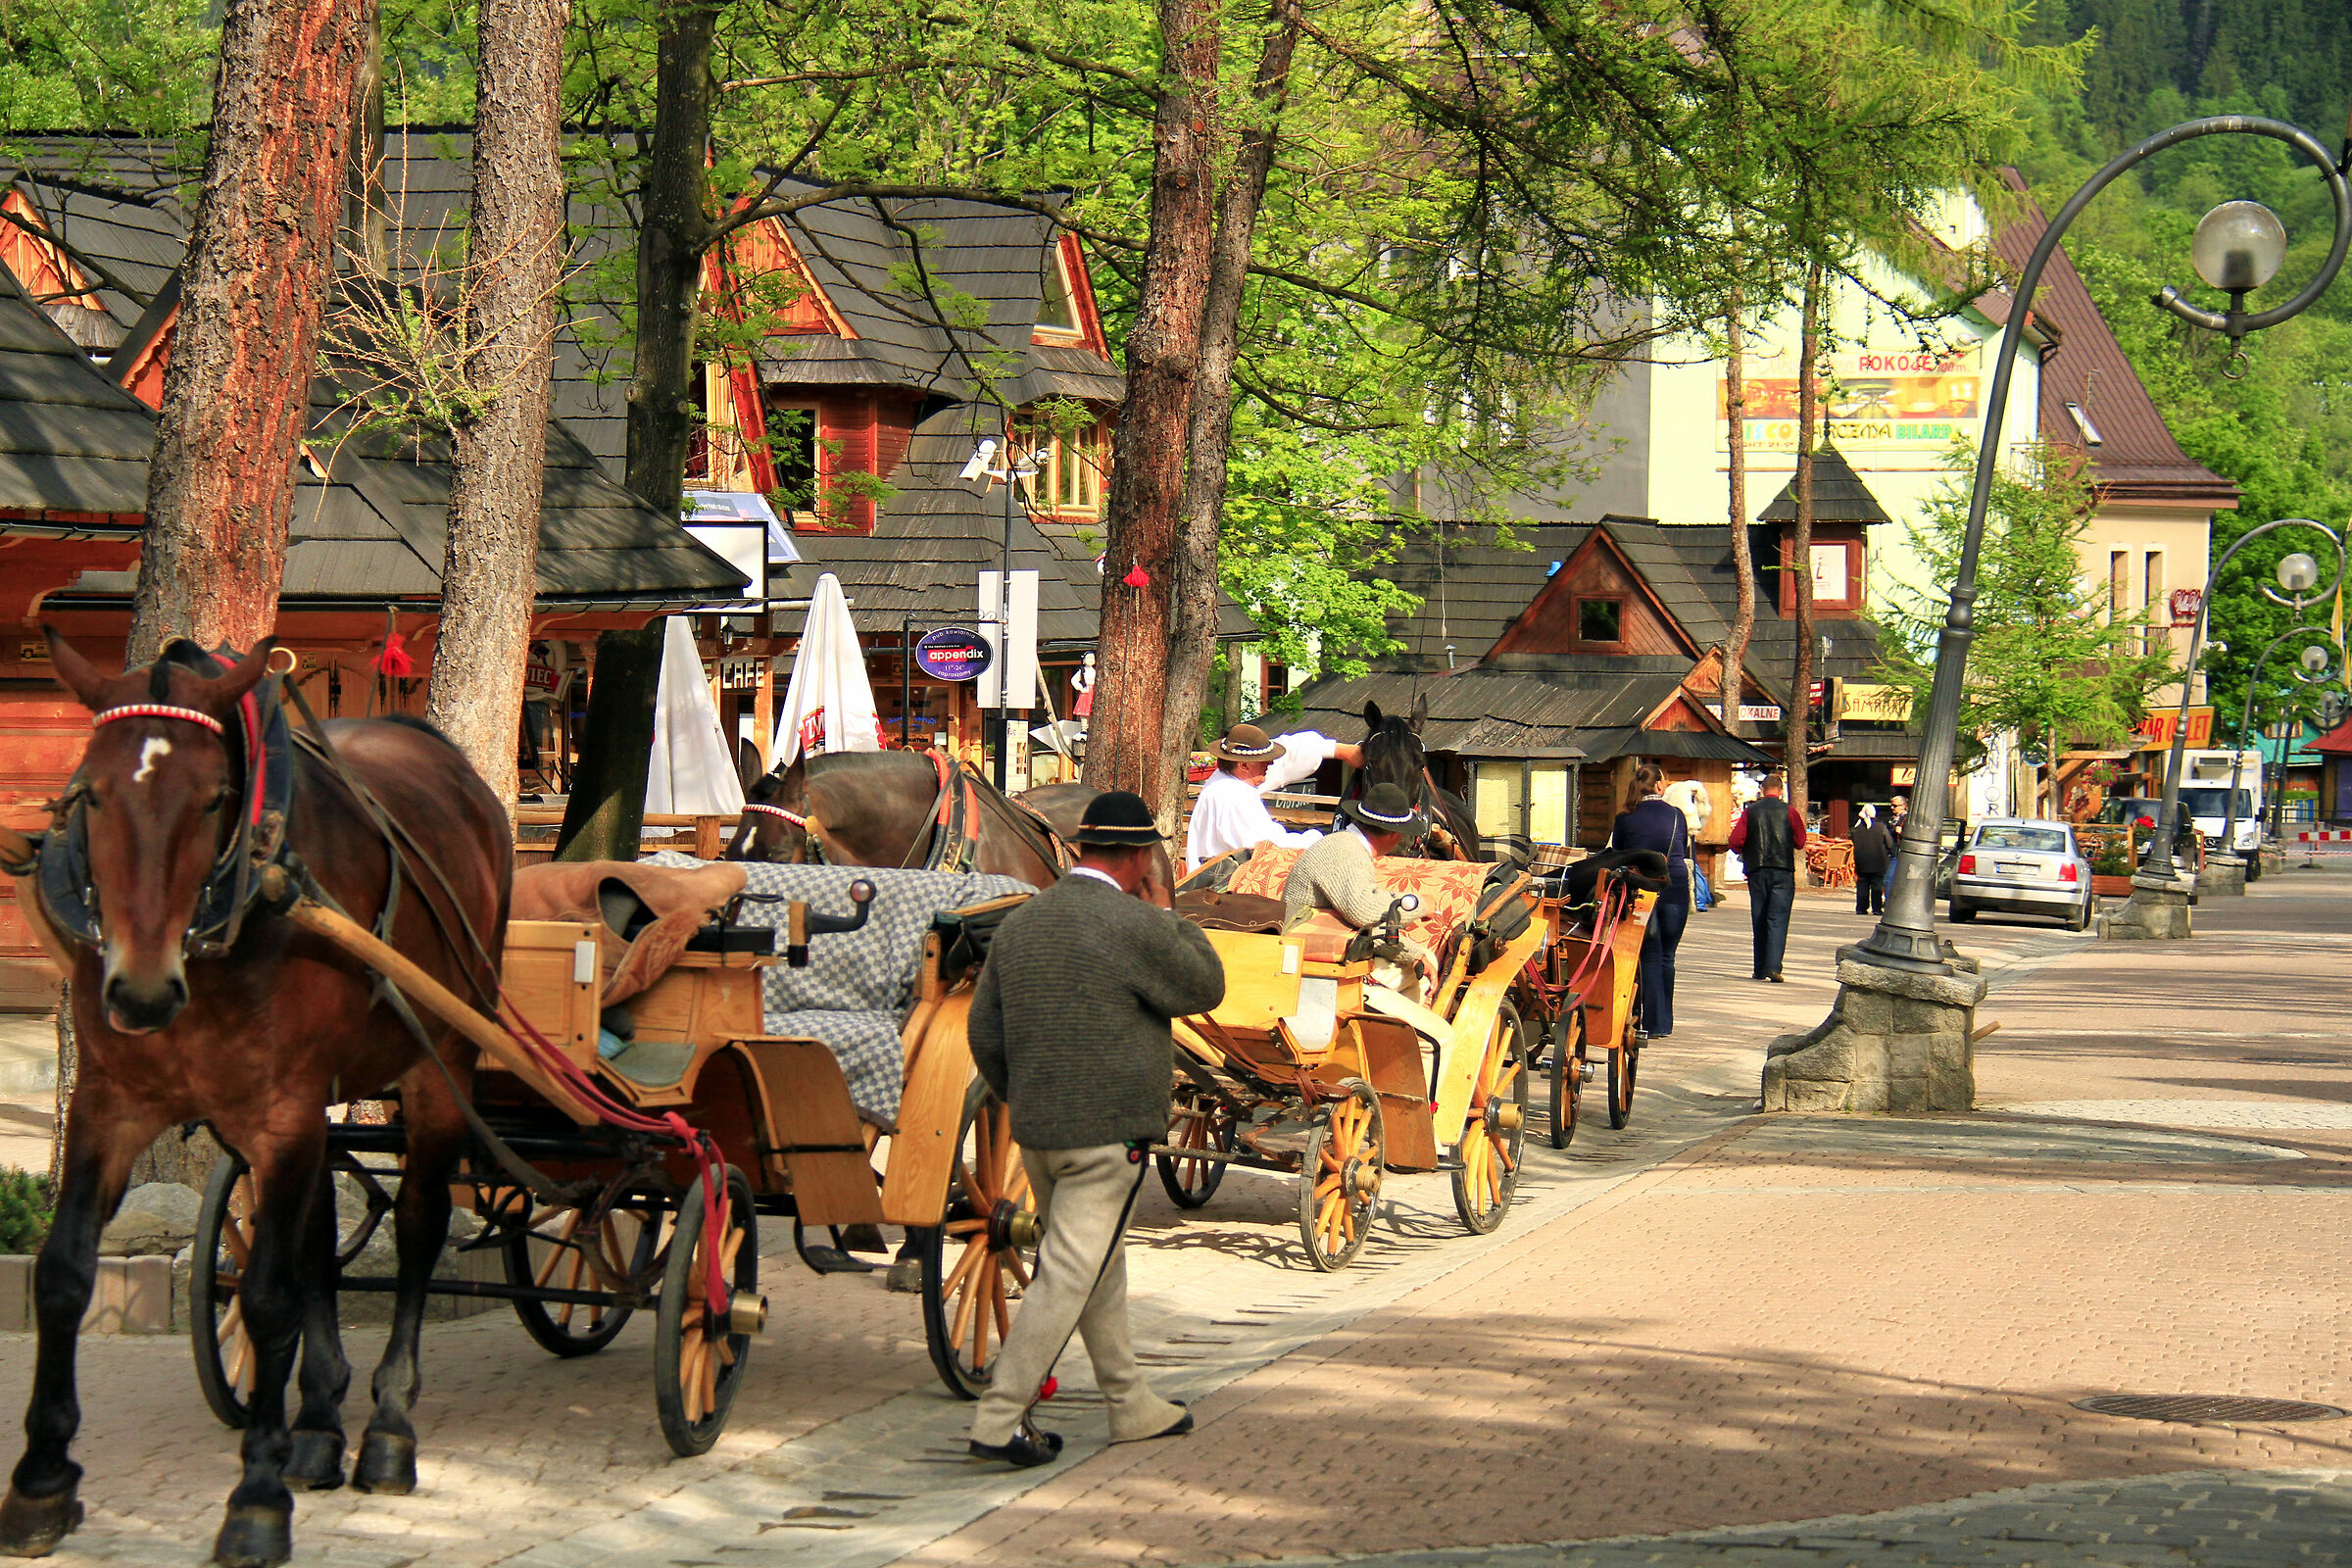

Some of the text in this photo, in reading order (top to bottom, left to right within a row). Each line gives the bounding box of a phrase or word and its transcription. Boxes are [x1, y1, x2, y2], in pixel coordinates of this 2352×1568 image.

[1859, 355, 1933, 371] POKOJE
[1744, 422, 1951, 440] ISCO ARCZMA BILARD
[929, 649, 984, 662] appendix
